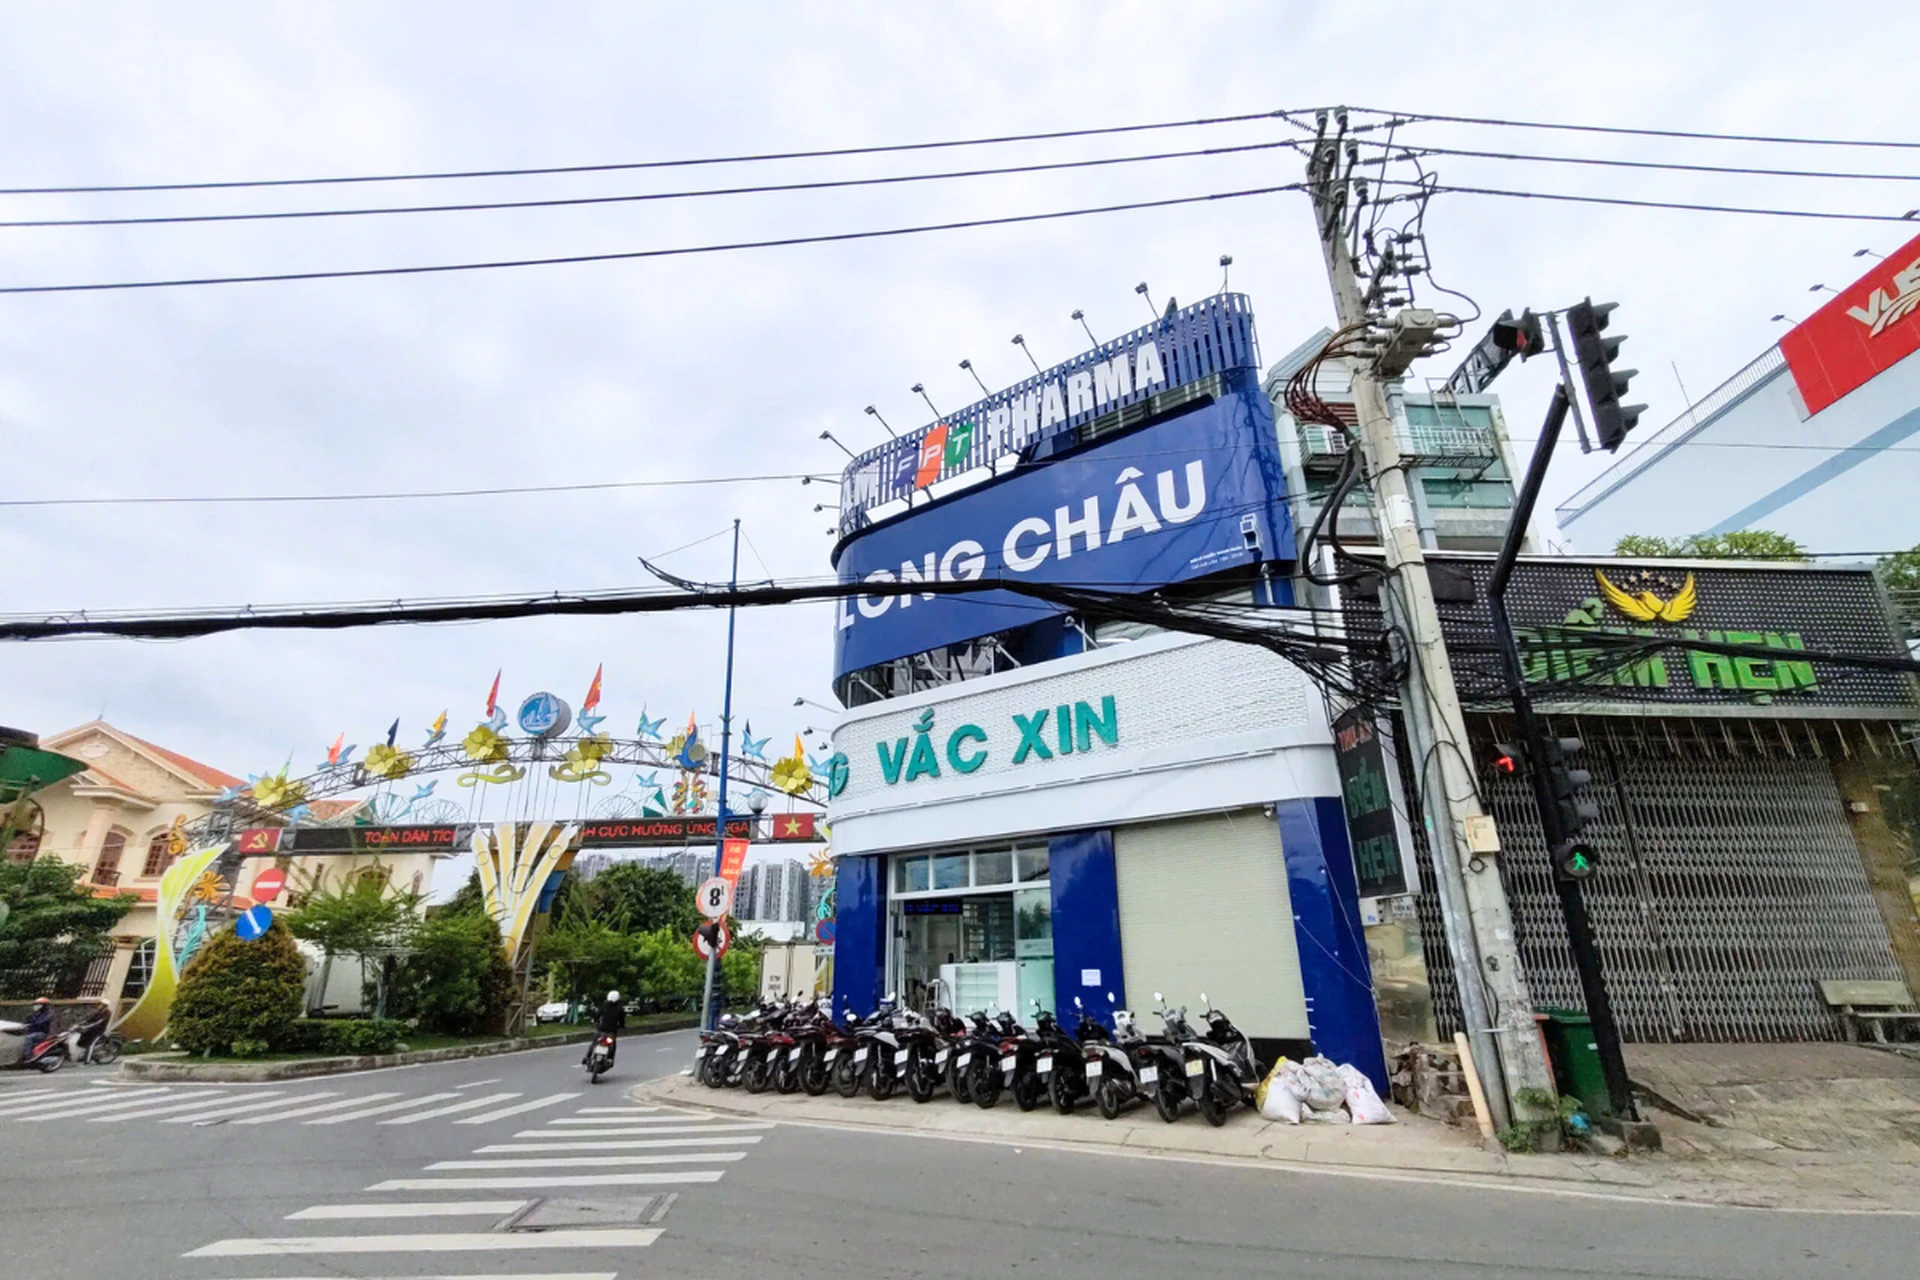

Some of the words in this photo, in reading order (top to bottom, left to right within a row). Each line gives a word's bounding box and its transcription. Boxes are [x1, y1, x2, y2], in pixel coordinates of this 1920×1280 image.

[894, 430, 970, 481] FPT
[989, 341, 1165, 450] PHARMA
[1003, 459, 1206, 572] CHÂU
[876, 708, 988, 784] VẮC
[1011, 695, 1118, 765] XIN
